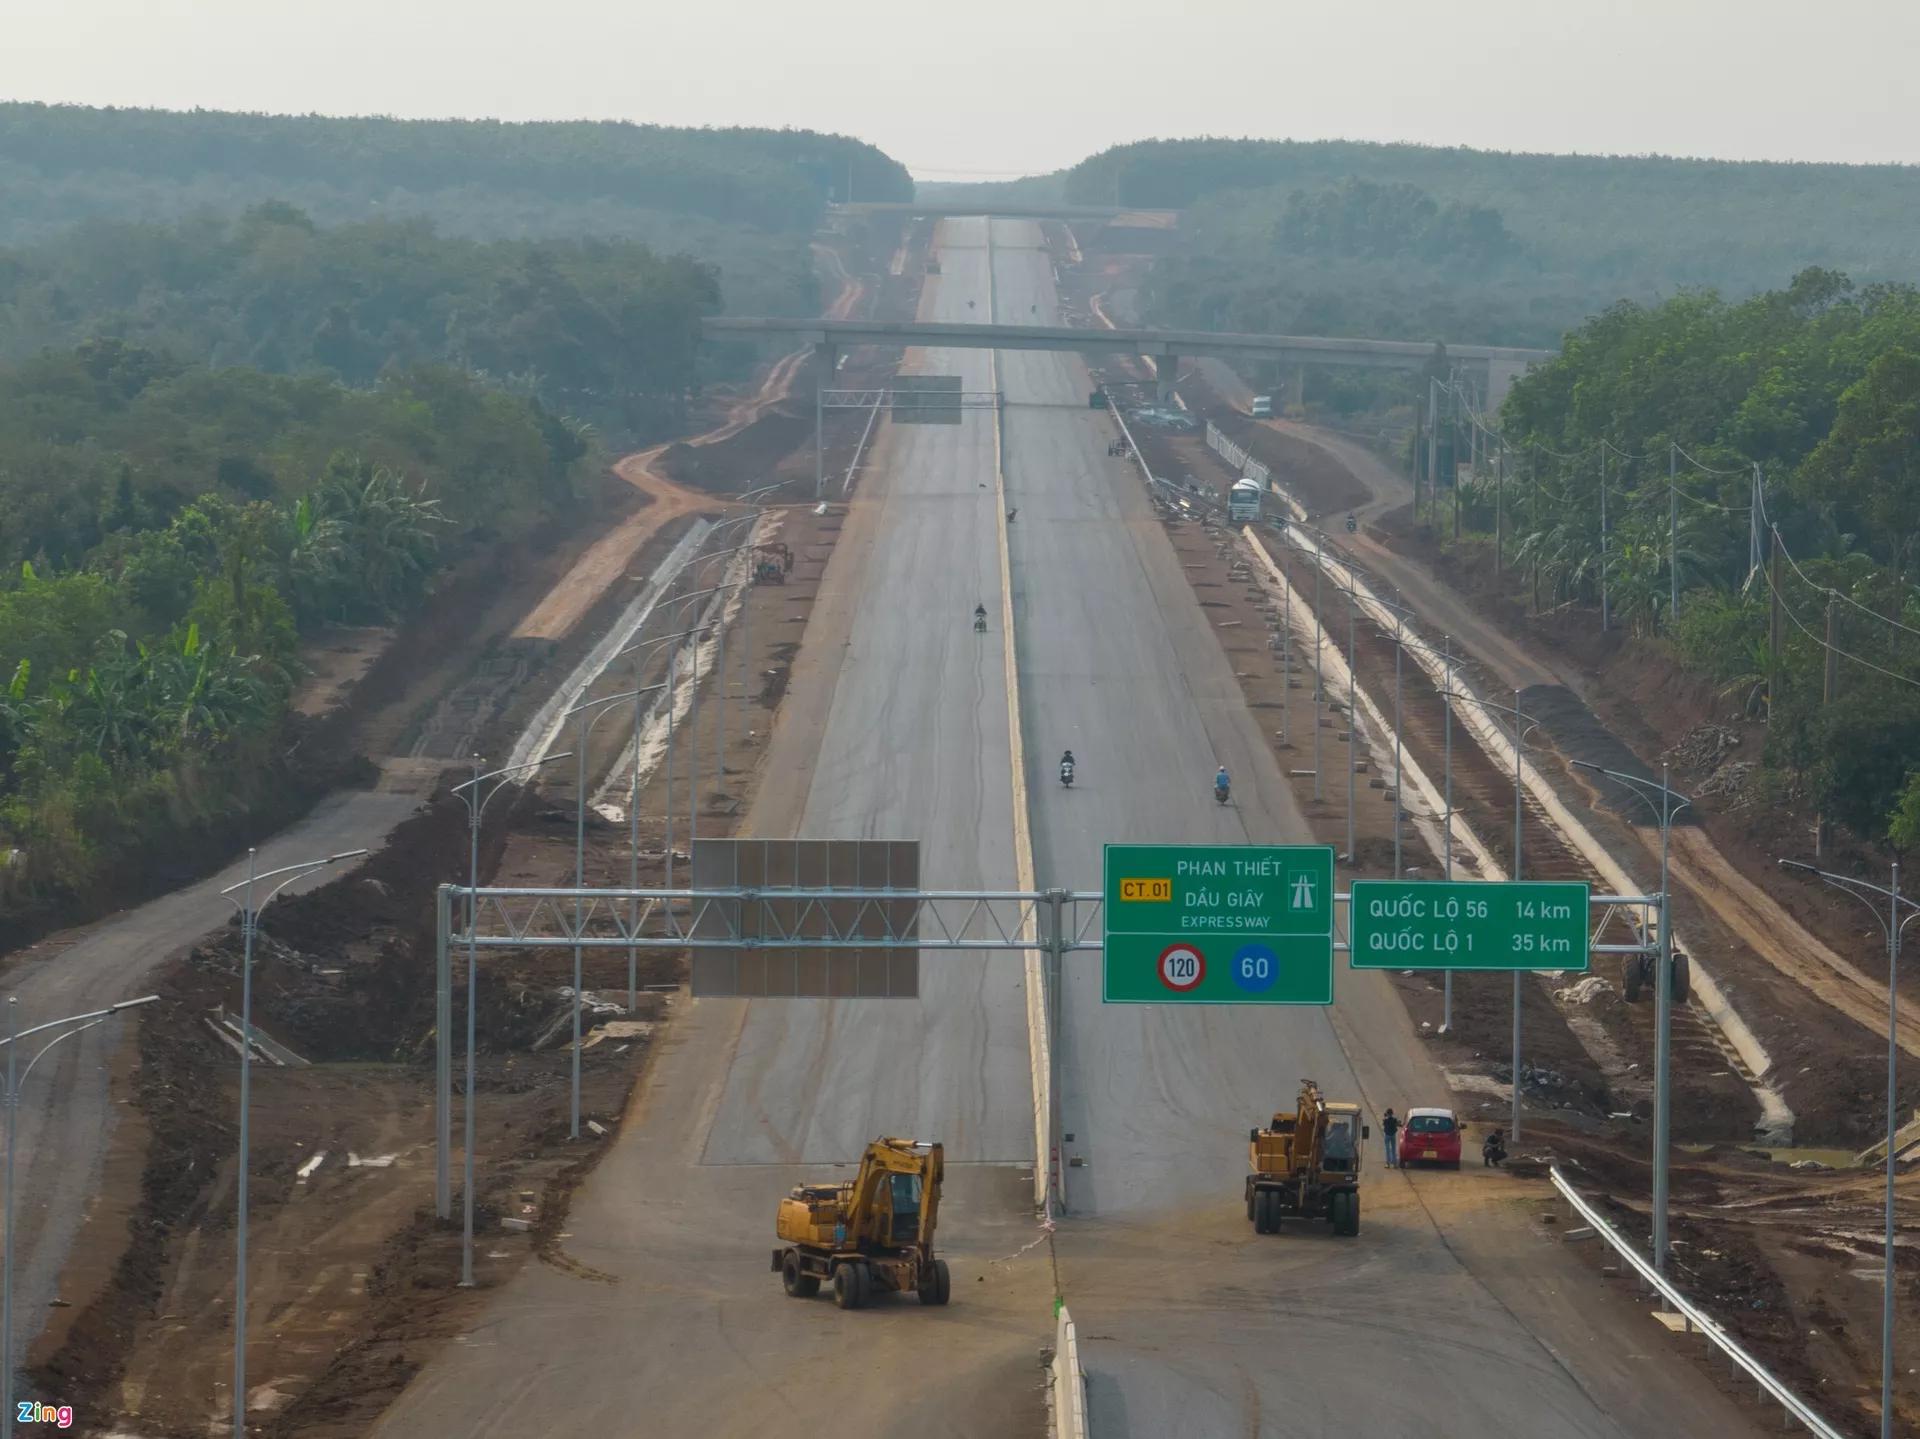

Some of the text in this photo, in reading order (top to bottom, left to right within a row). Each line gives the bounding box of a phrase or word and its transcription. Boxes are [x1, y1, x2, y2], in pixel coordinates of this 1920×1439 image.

[1177, 855, 1282, 876] PHAN THIẾT
[1123, 882, 1169, 898] CT.01
[1227, 889, 1264, 908] GIÂY
[1370, 893, 1572, 922] QUỐC LỘ 56 14 km
[1181, 915, 1270, 928] EXPRESSWAY
[1369, 925, 1571, 954] QUỐC LỘ 1 35 km
[1168, 957, 1195, 978] 120
[1241, 957, 1269, 979] 60
